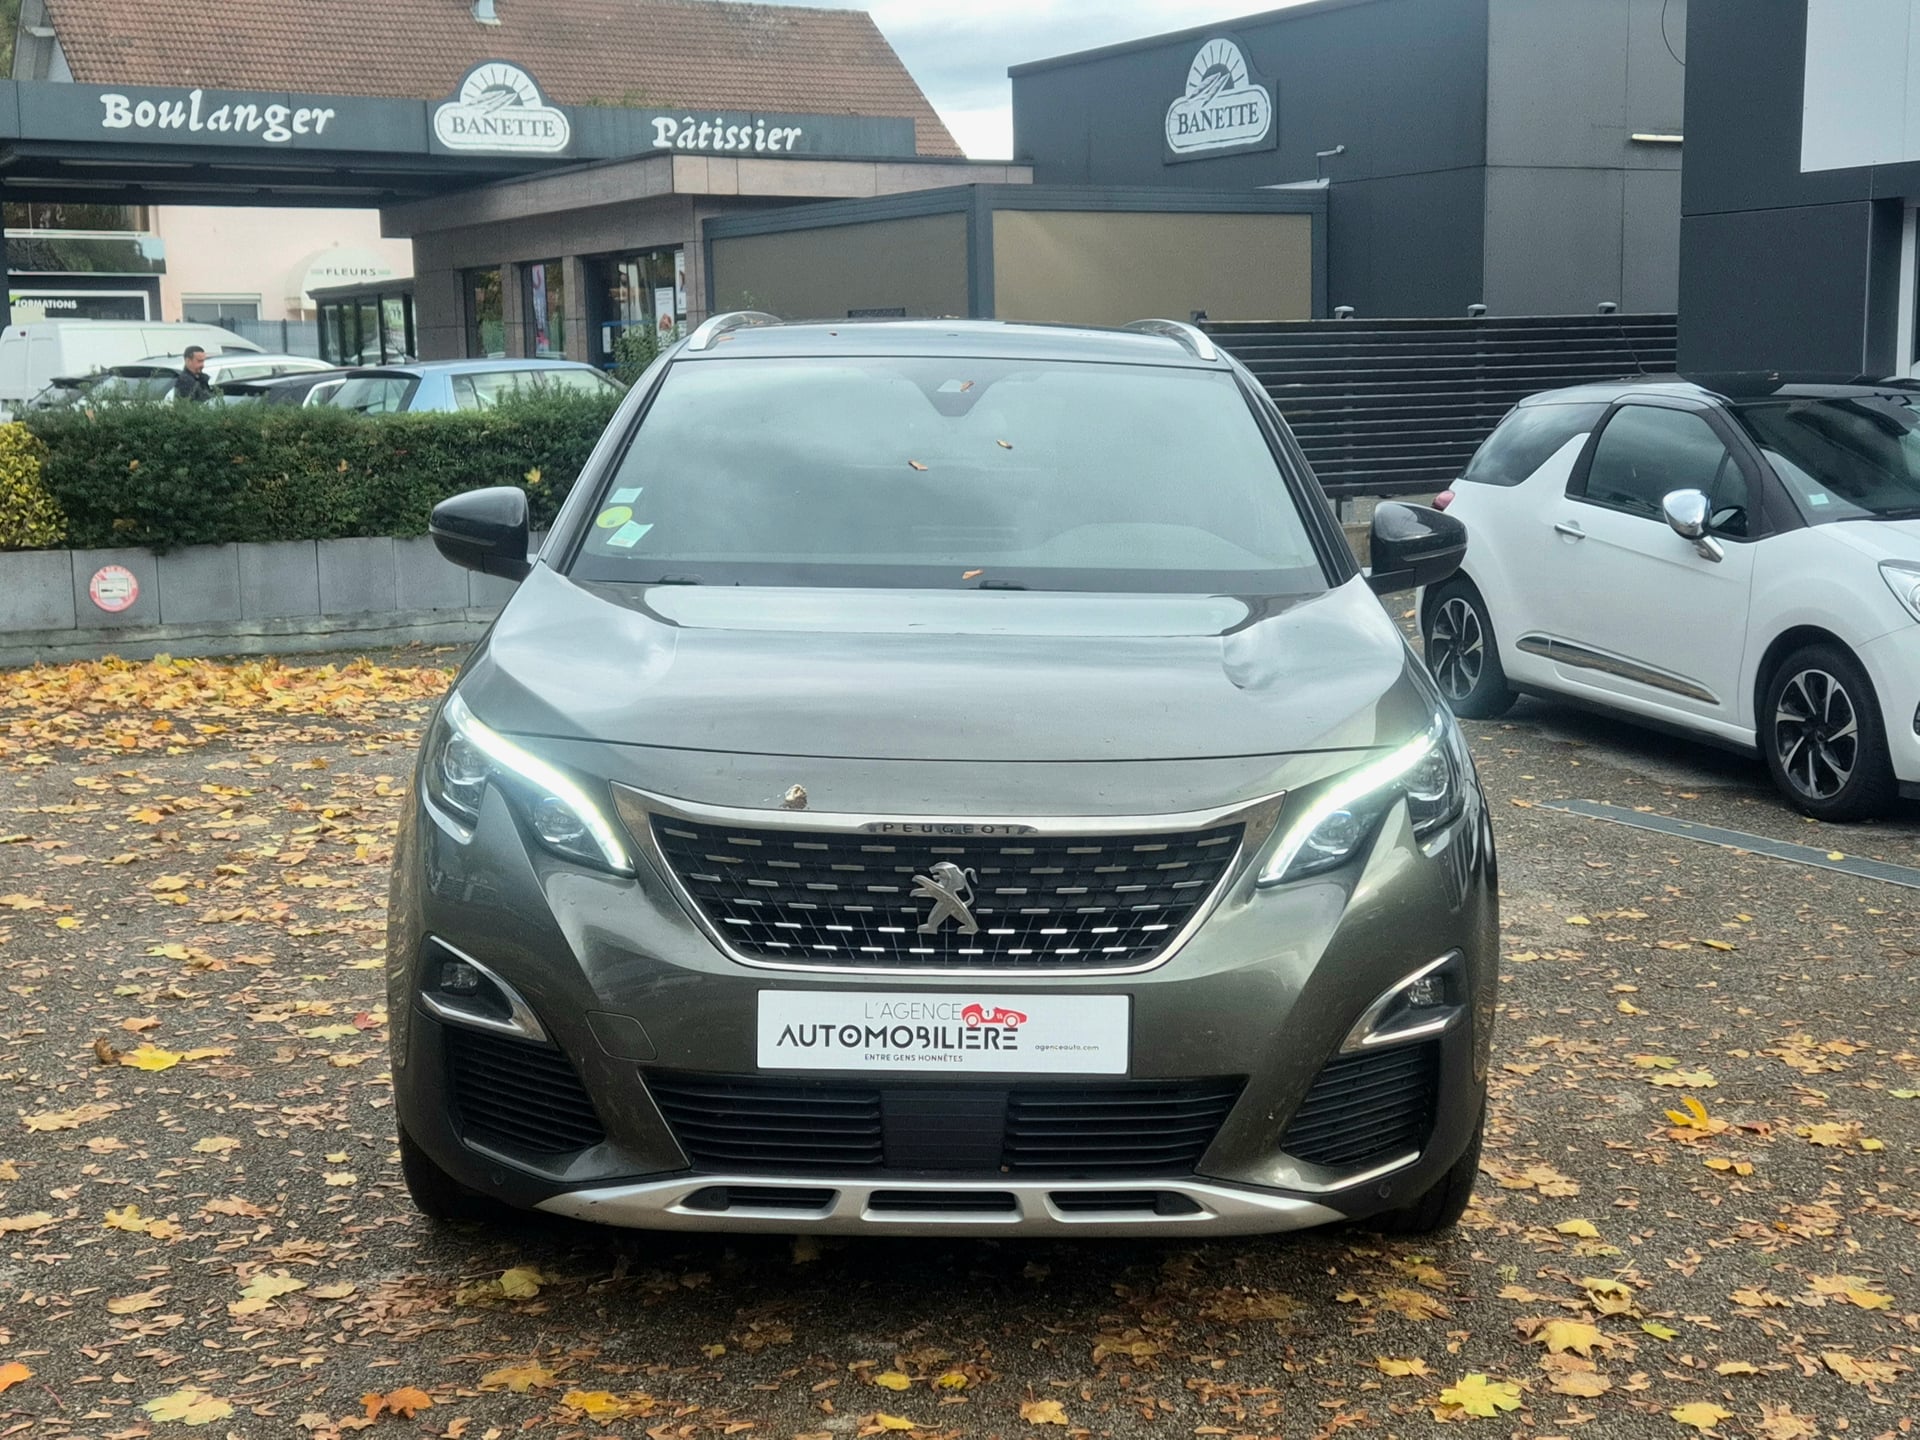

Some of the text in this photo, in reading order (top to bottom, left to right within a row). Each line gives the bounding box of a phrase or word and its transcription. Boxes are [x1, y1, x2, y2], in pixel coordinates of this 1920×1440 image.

[100, 88, 336, 142] Boulanger
[1177, 102, 1259, 135] BANETTE
[452, 116, 555, 137] BANETTE
[650, 115, 802, 151] Pâtissier
[325, 267, 377, 276] FLEURS
[14, 299, 78, 309] FORMATIONS
[882, 823, 1013, 834] PEUGEOT
[1034, 1043, 1100, 1052] agenceauto.com
[864, 1052, 963, 1063] ENTRE GENS HONNÊTES
